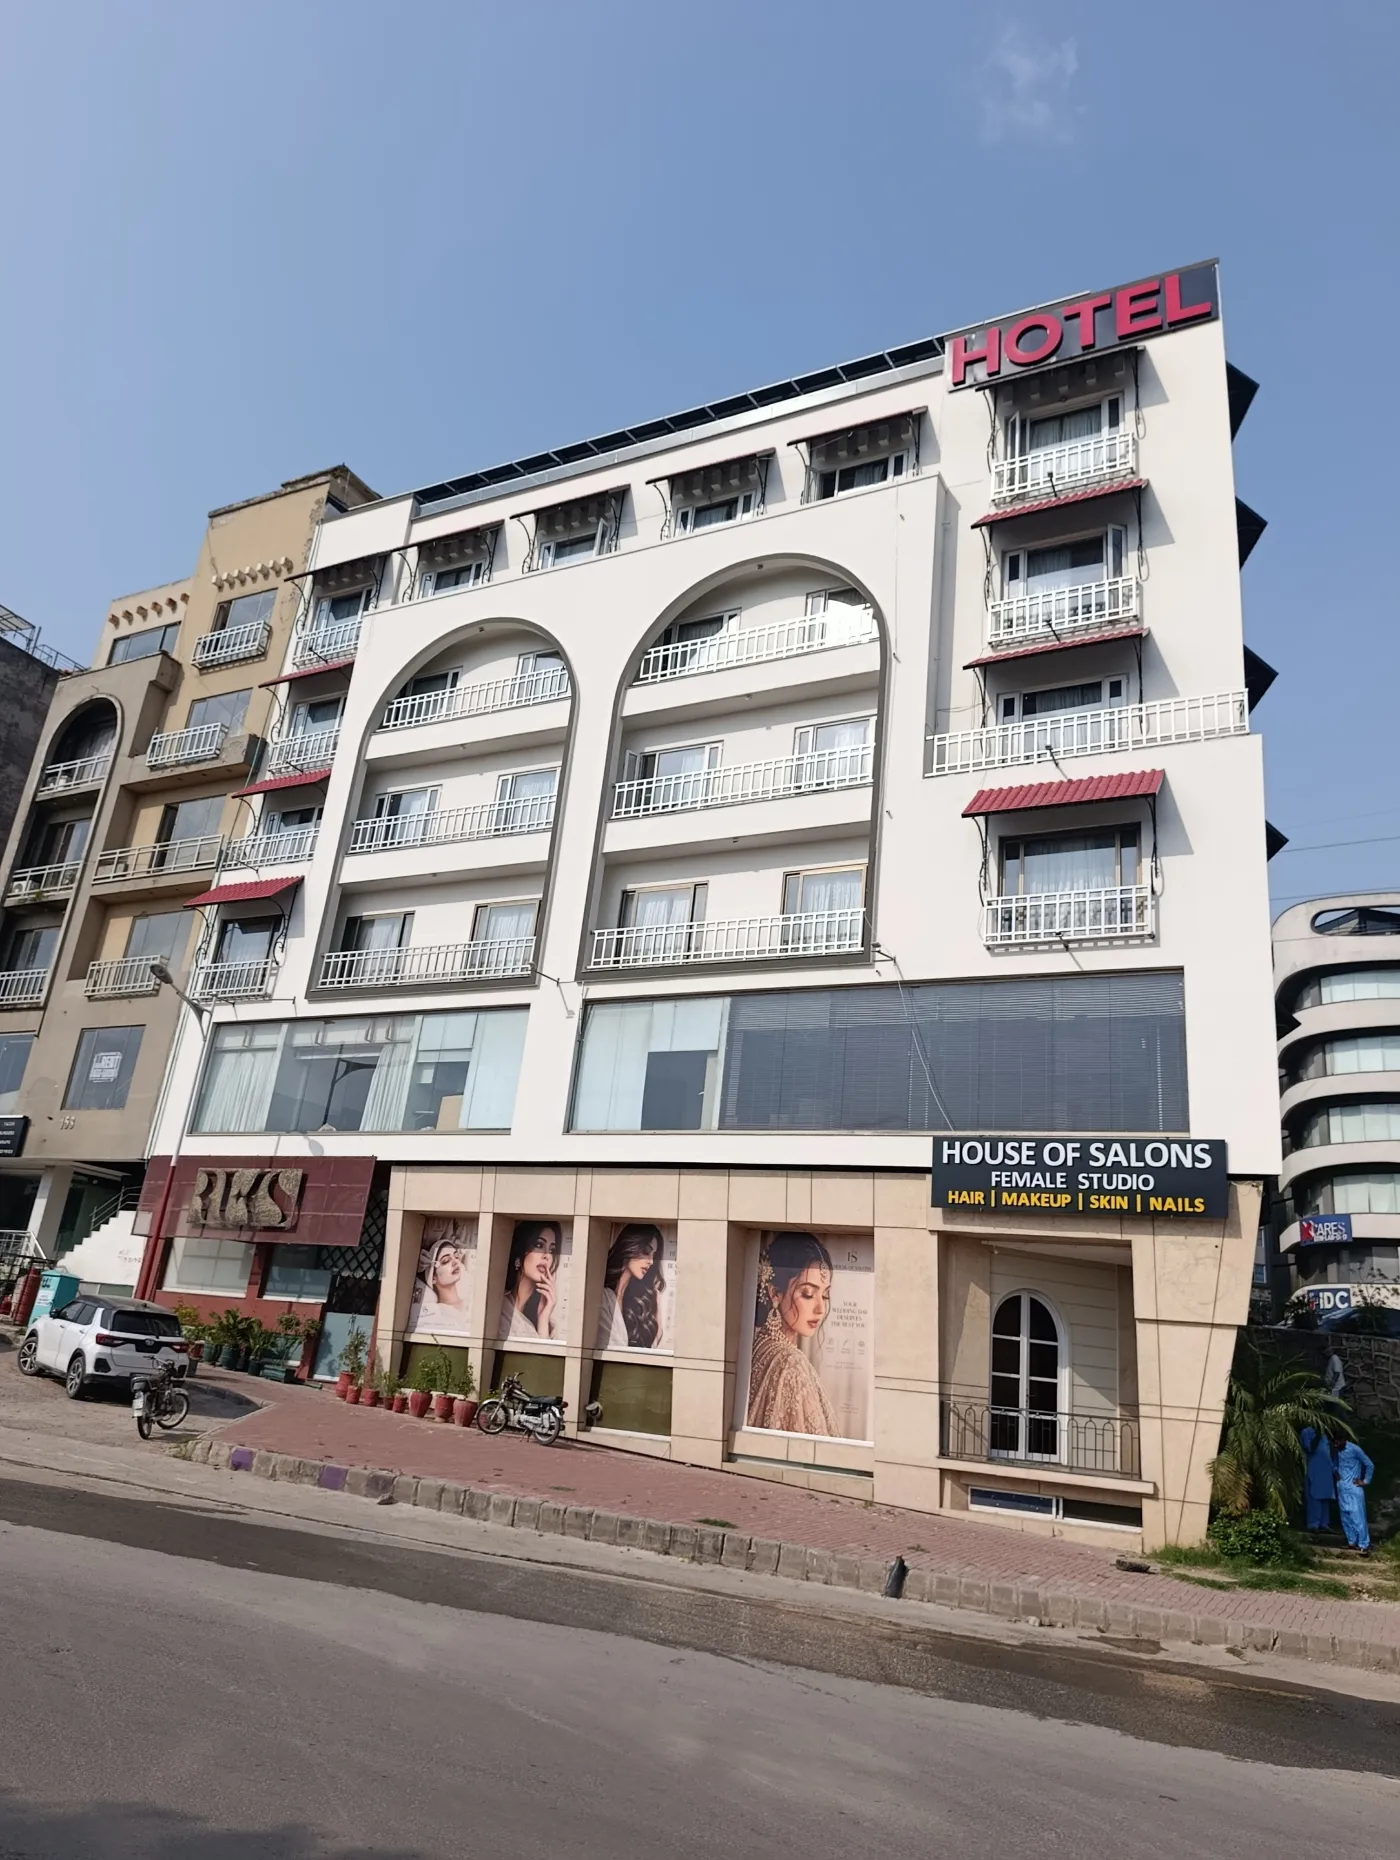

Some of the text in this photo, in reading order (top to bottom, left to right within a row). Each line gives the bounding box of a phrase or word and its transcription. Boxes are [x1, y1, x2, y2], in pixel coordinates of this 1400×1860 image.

[951, 273, 1212, 387] HOTEL
[942, 1140, 1213, 1169] HOUSE OF SALONS
[991, 1171, 1155, 1191] FEMALE STUDIO
[947, 1190, 985, 1205] HAIR
[1001, 1191, 1072, 1208] MAKEUP
[1089, 1194, 1129, 1210] SKIN
[1149, 1196, 1205, 1213] NAILS
